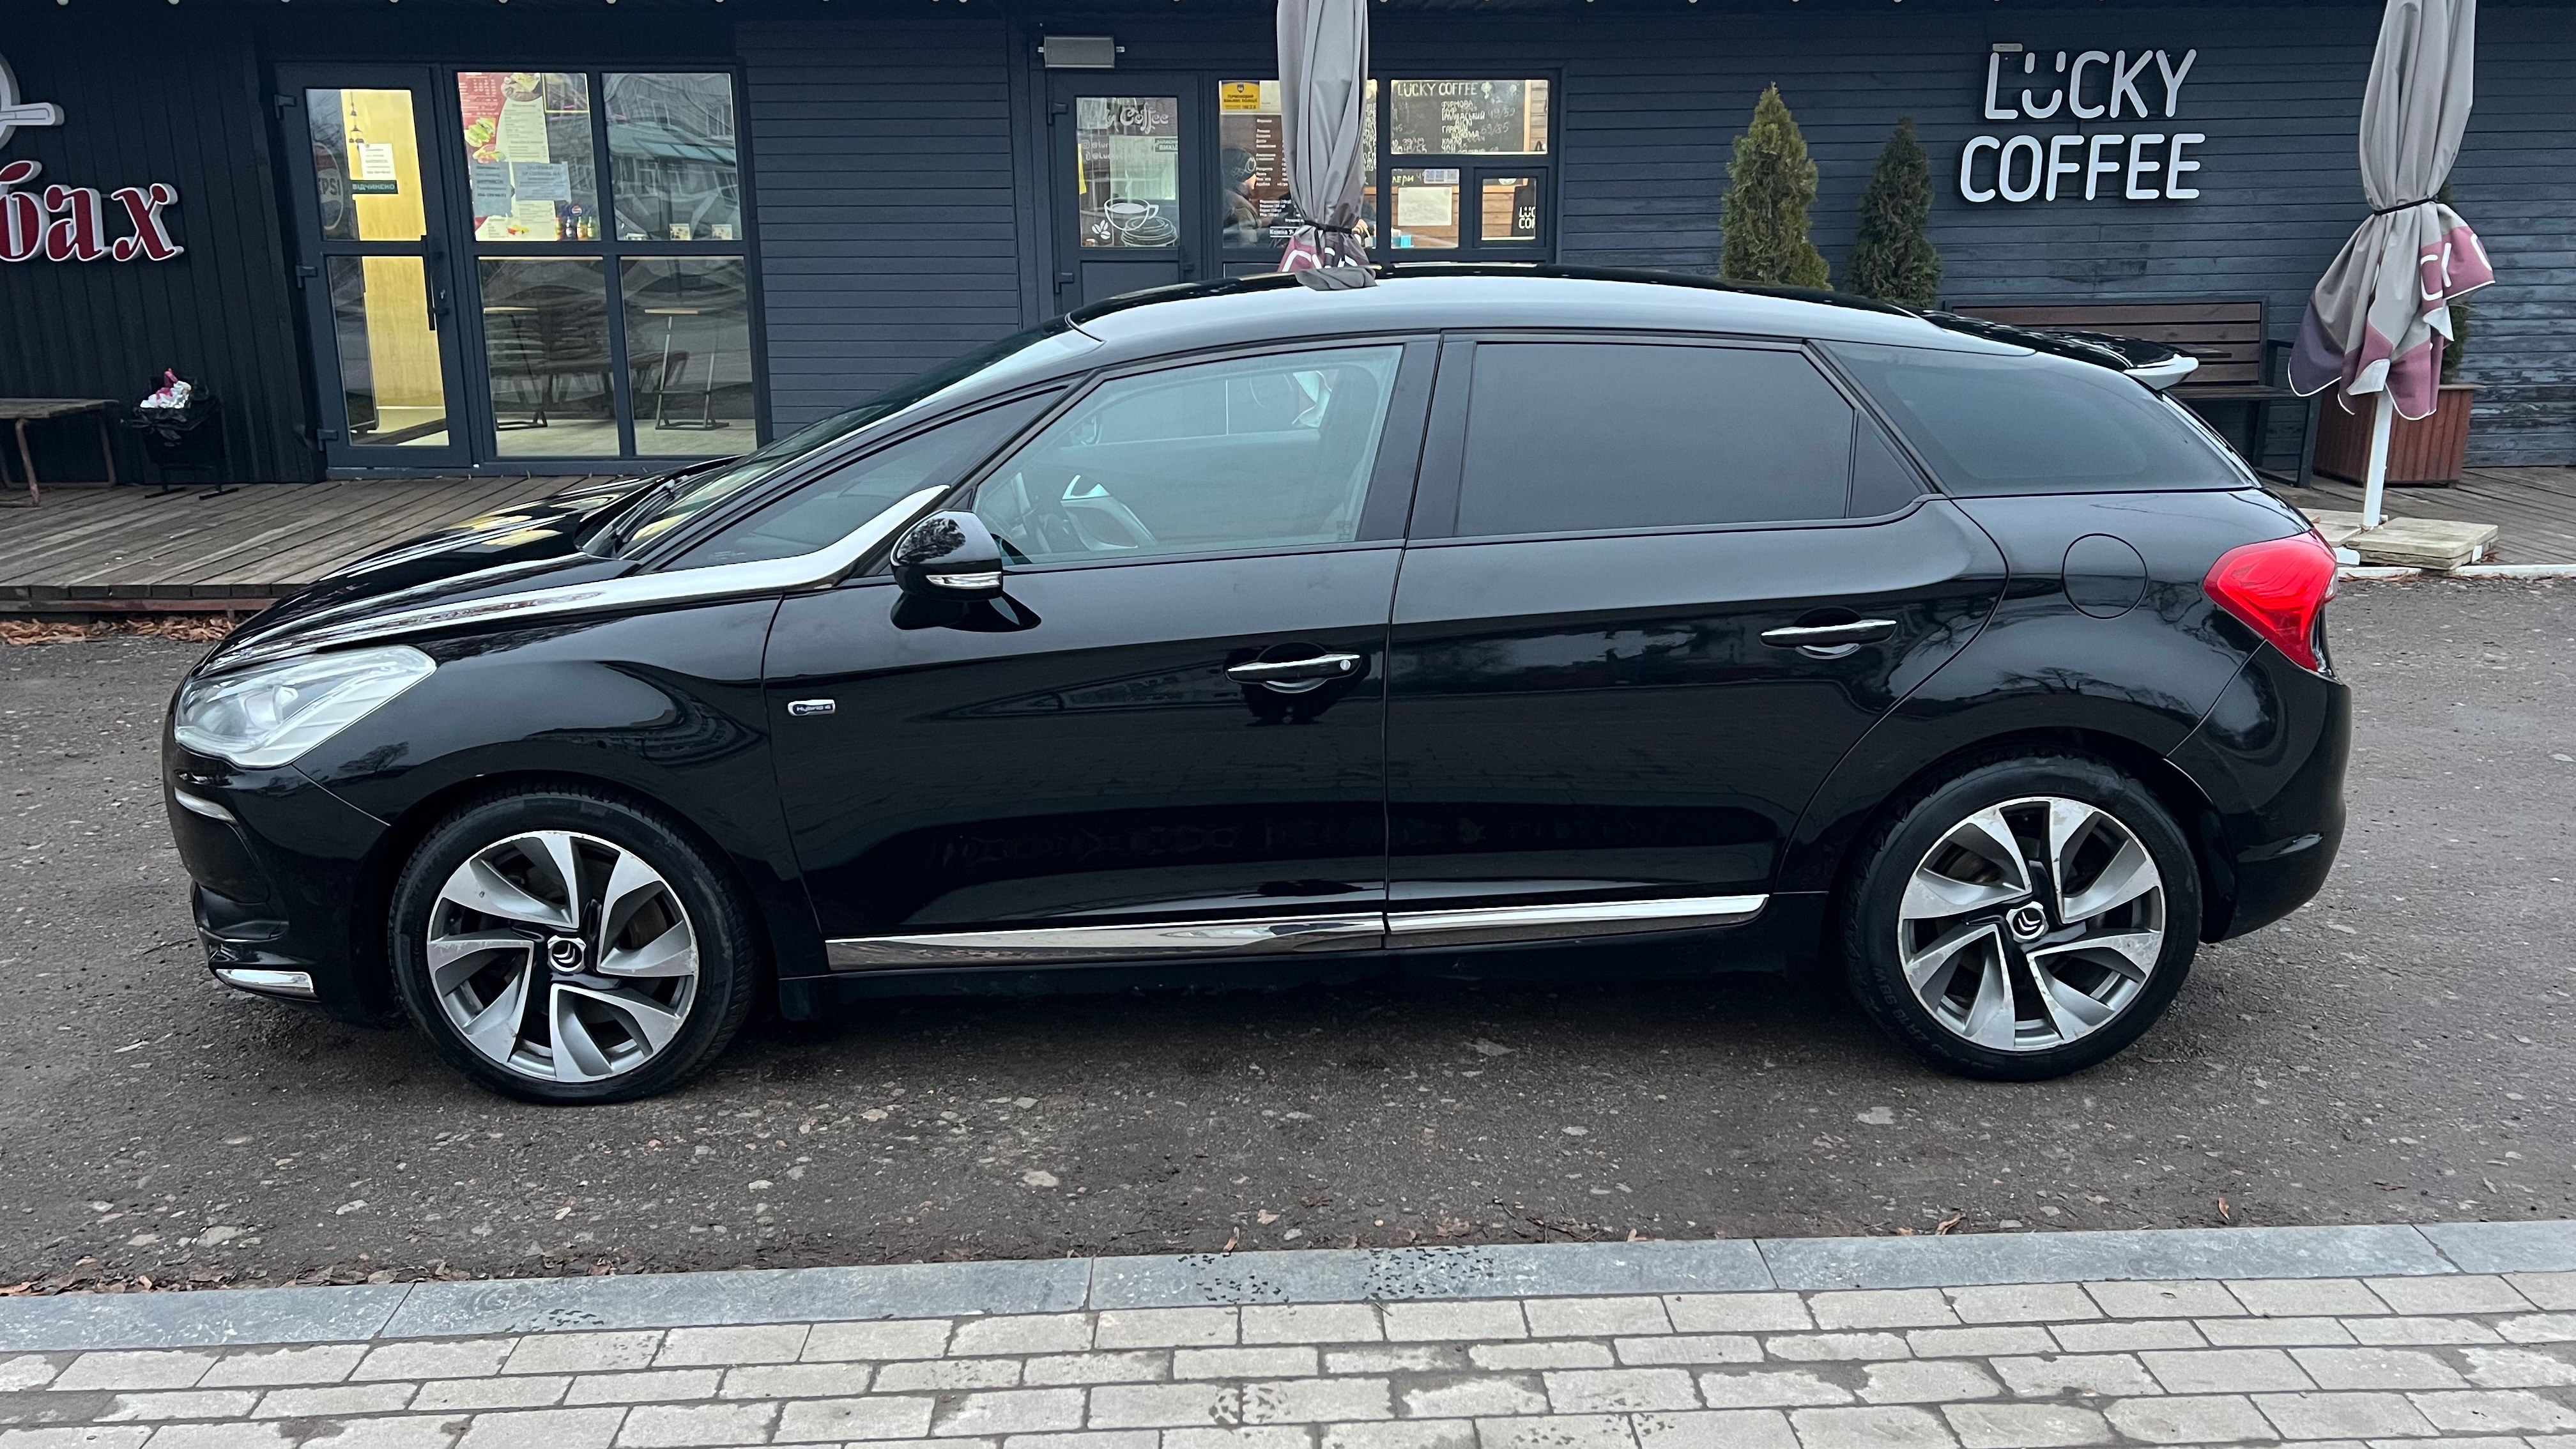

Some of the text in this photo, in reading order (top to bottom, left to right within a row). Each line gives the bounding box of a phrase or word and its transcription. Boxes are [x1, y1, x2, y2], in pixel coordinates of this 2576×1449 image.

[1398, 82, 1436, 97] LUCKY
[1985, 49, 2196, 119] LUCKY
[1120, 102, 1169, 134] Coffee
[1961, 134, 2205, 202] COFFEE
